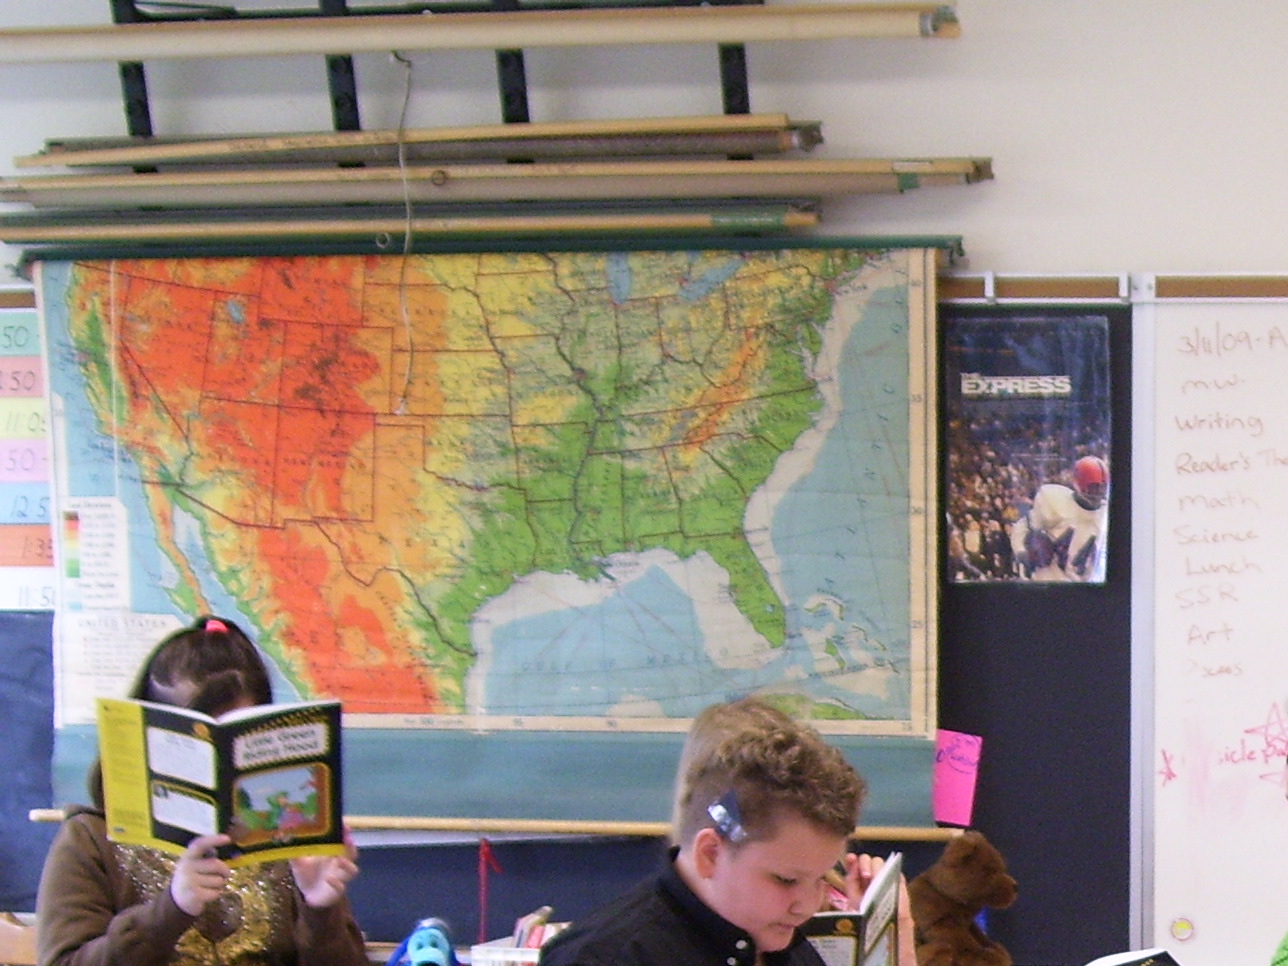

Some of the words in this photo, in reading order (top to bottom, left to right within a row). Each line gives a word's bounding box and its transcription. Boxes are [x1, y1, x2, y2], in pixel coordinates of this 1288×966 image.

[961, 375, 1072, 394] EXPRESS
[1175, 452, 1251, 474] Reader's
[1172, 525, 1259, 546] Science
[1185, 557, 1263, 576] Lunch
[1175, 583, 1239, 609] SSR
[1187, 622, 1234, 645] Art
